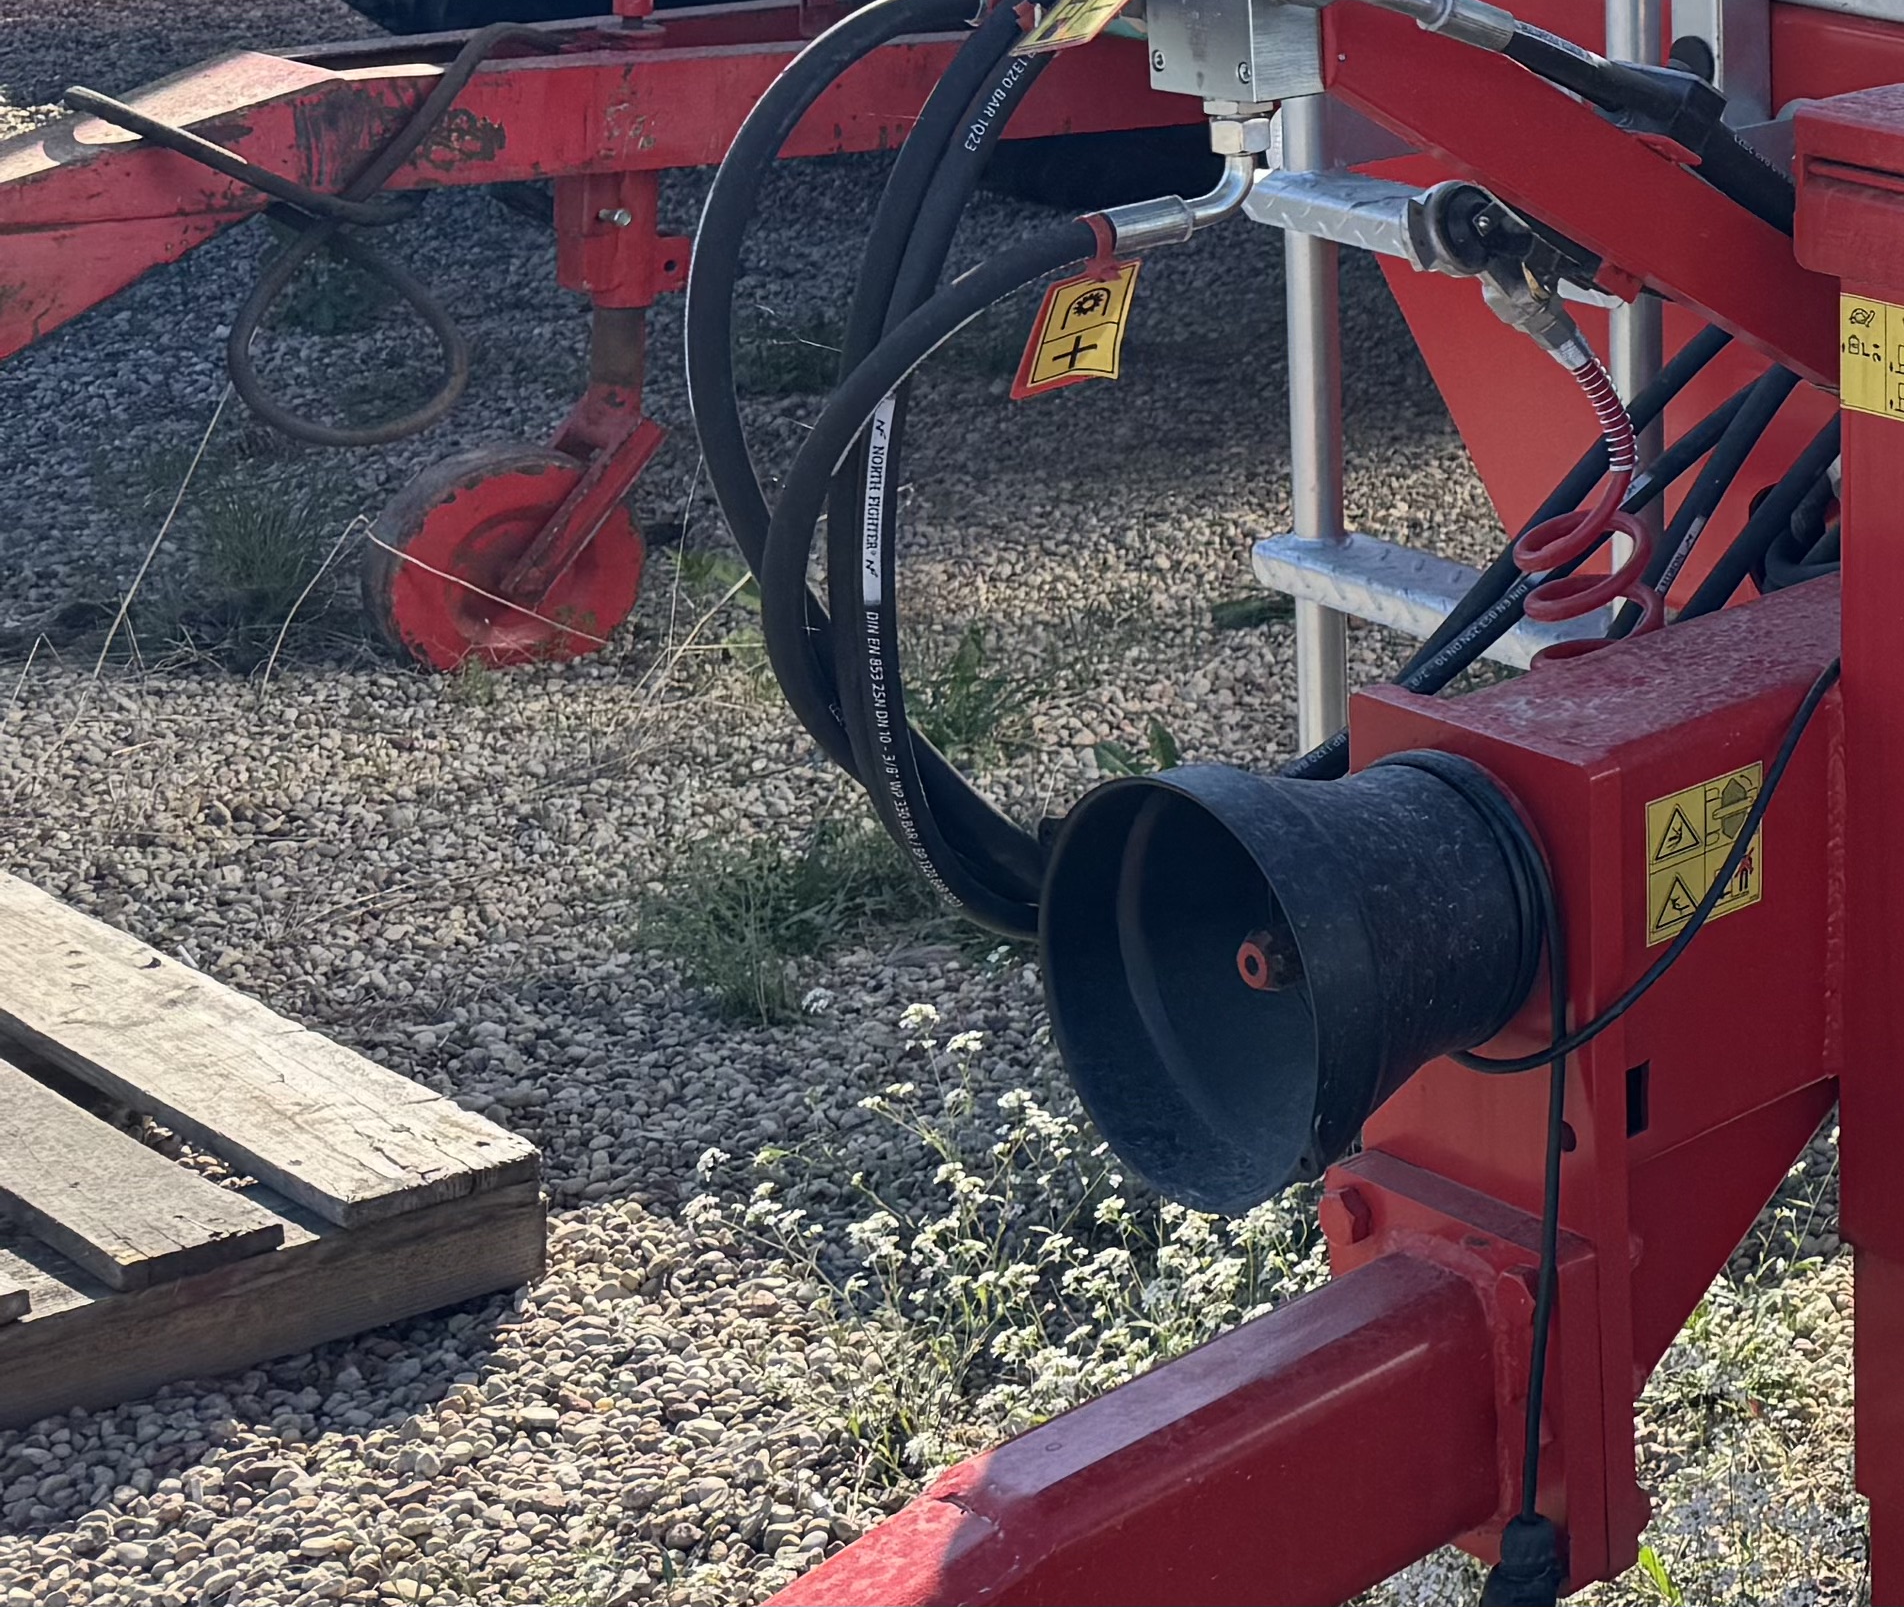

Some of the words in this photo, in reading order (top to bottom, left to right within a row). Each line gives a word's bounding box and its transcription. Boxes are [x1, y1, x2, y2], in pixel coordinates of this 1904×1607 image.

[1001, 58, 1028, 89] 1320
[983, 88, 1007, 117] BAR
[964, 119, 989, 152] 1Q23
[869, 445, 885, 491] NORTH
[866, 611, 879, 635] DIN
[868, 637, 880, 655] EN
[869, 658, 884, 681] 853
[876, 710, 889, 728] DN
[879, 731, 892, 744] 10
